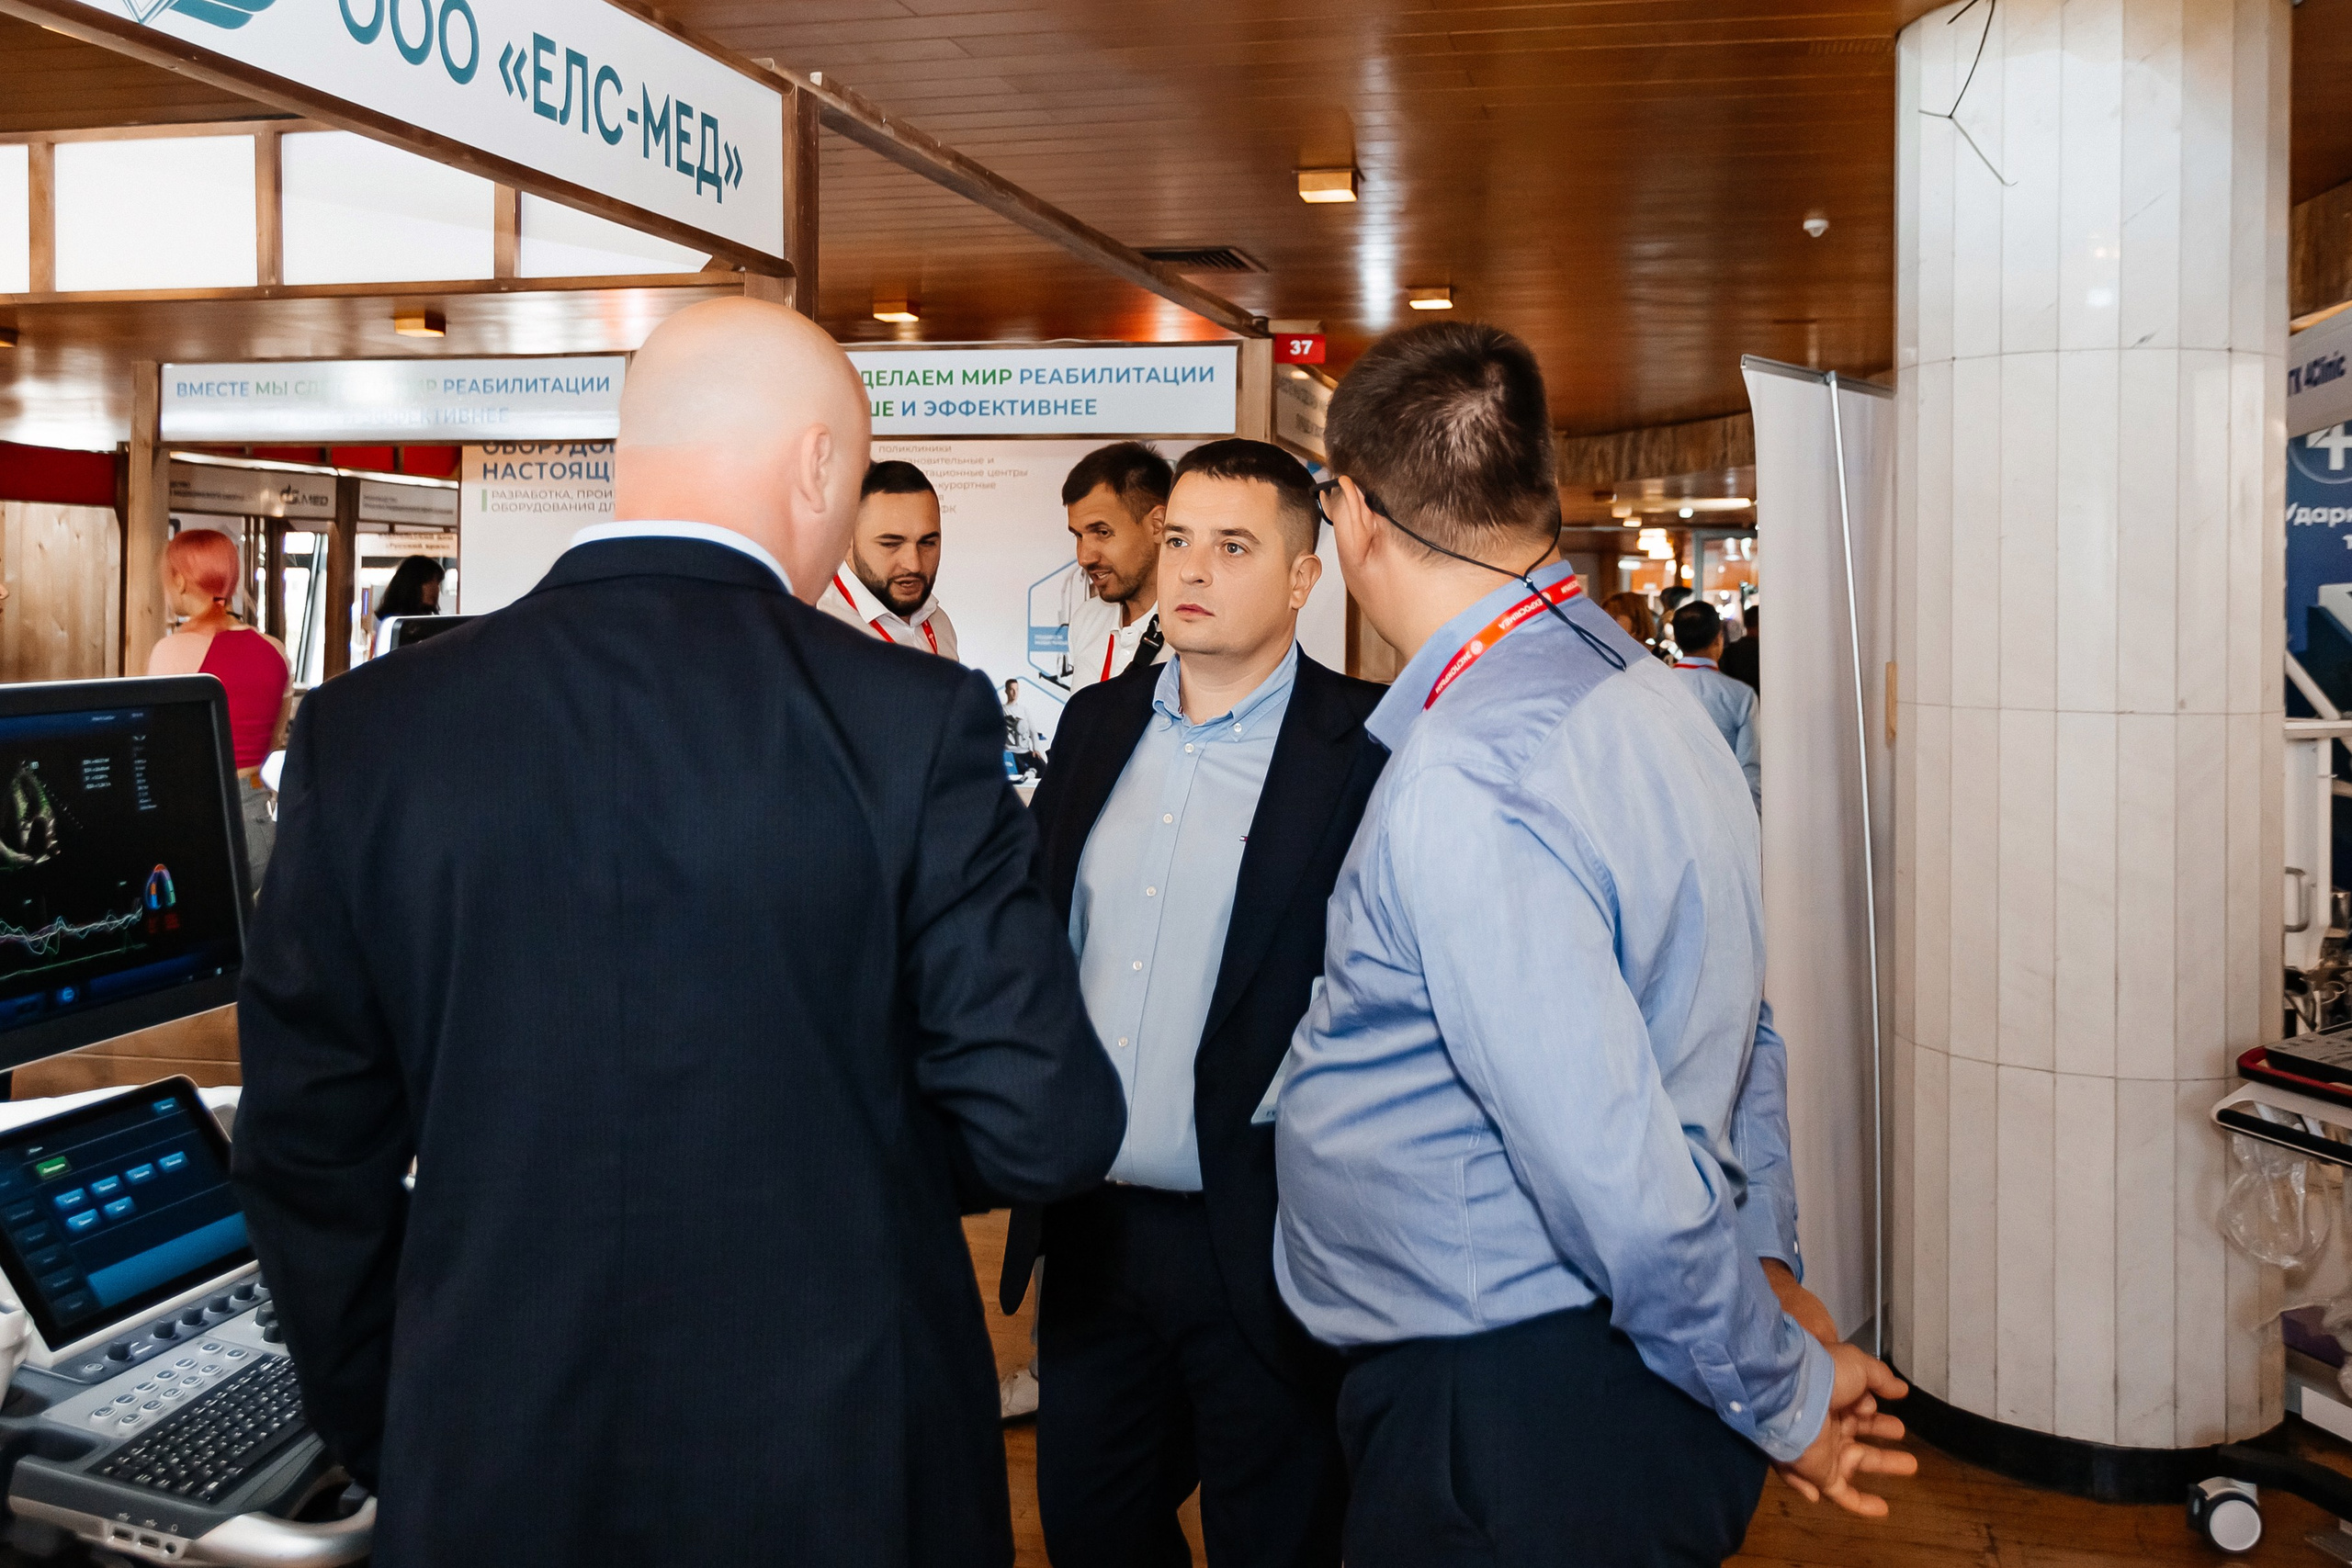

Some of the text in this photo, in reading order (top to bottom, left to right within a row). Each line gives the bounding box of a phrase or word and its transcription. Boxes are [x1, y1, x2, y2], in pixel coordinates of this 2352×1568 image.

[499, 32, 743, 204] «ЕЛС-МЕД»
[1290, 340, 1313, 355] 37
[861, 367, 1216, 389] ДЕЛАЕМ МИР РЕАБИЛИТАЦИИ
[176, 381, 249, 398] ВМЕСТЕ
[255, 381, 287, 395] МЫ
[443, 377, 610, 395] РЕАБИЛИТАЦИИ
[869, 399, 1097, 417] ШЕ И ЭФФЕКТИВНЕЕ
[482, 444, 614, 457] ОБОРУДО
[878, 446, 952, 454] поликлиники
[482, 462, 615, 482] НАСТОЯЩ
[988, 469, 1028, 478] центры
[492, 489, 573, 500] РАЗРАБОТКА,
[492, 502, 594, 513] ОБОРУДОВАНИЯ
[942, 504, 956, 513] ФК
[1498, 598, 1544, 629] EXPOCRIMEA
[1435, 650, 1473, 694] ЭКСПОКРЫМ
